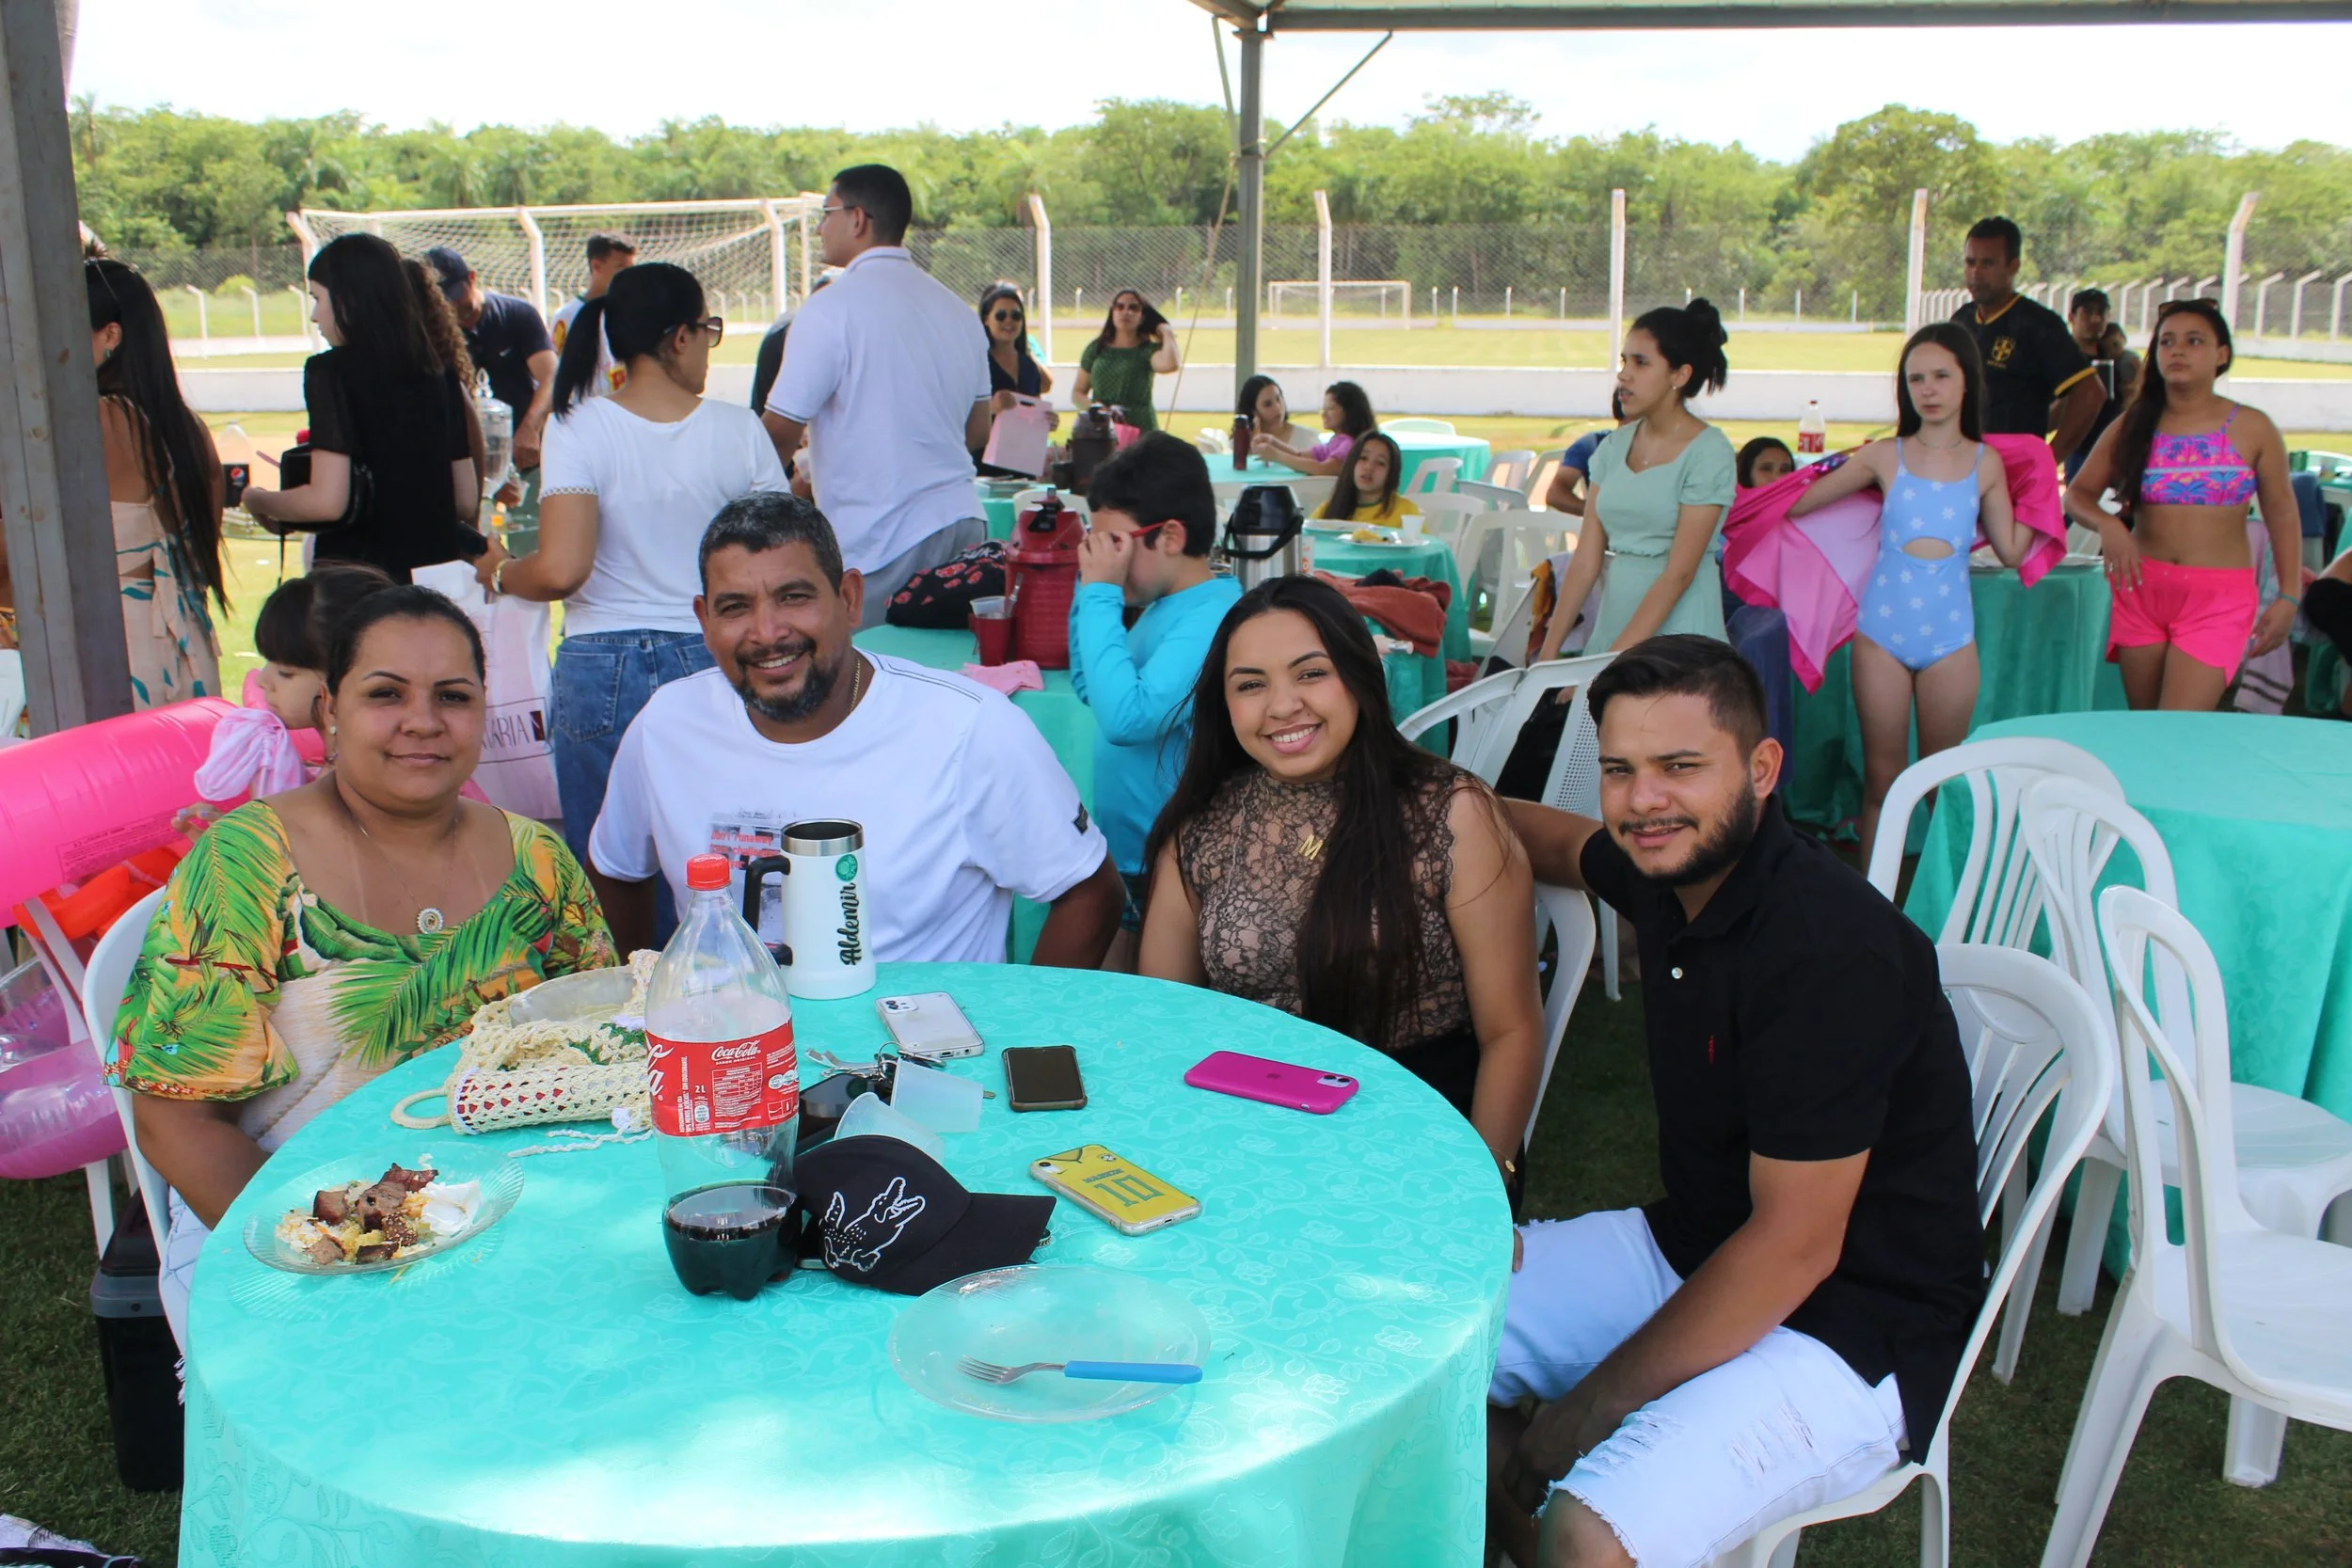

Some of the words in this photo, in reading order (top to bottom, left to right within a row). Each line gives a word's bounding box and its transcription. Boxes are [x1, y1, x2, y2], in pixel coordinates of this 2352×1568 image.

[482, 714, 531, 749] TARIA
[836, 882, 863, 966] Aldemir
[711, 1039, 761, 1062] Coca-Cola
[1093, 1174, 1165, 1208] 10
